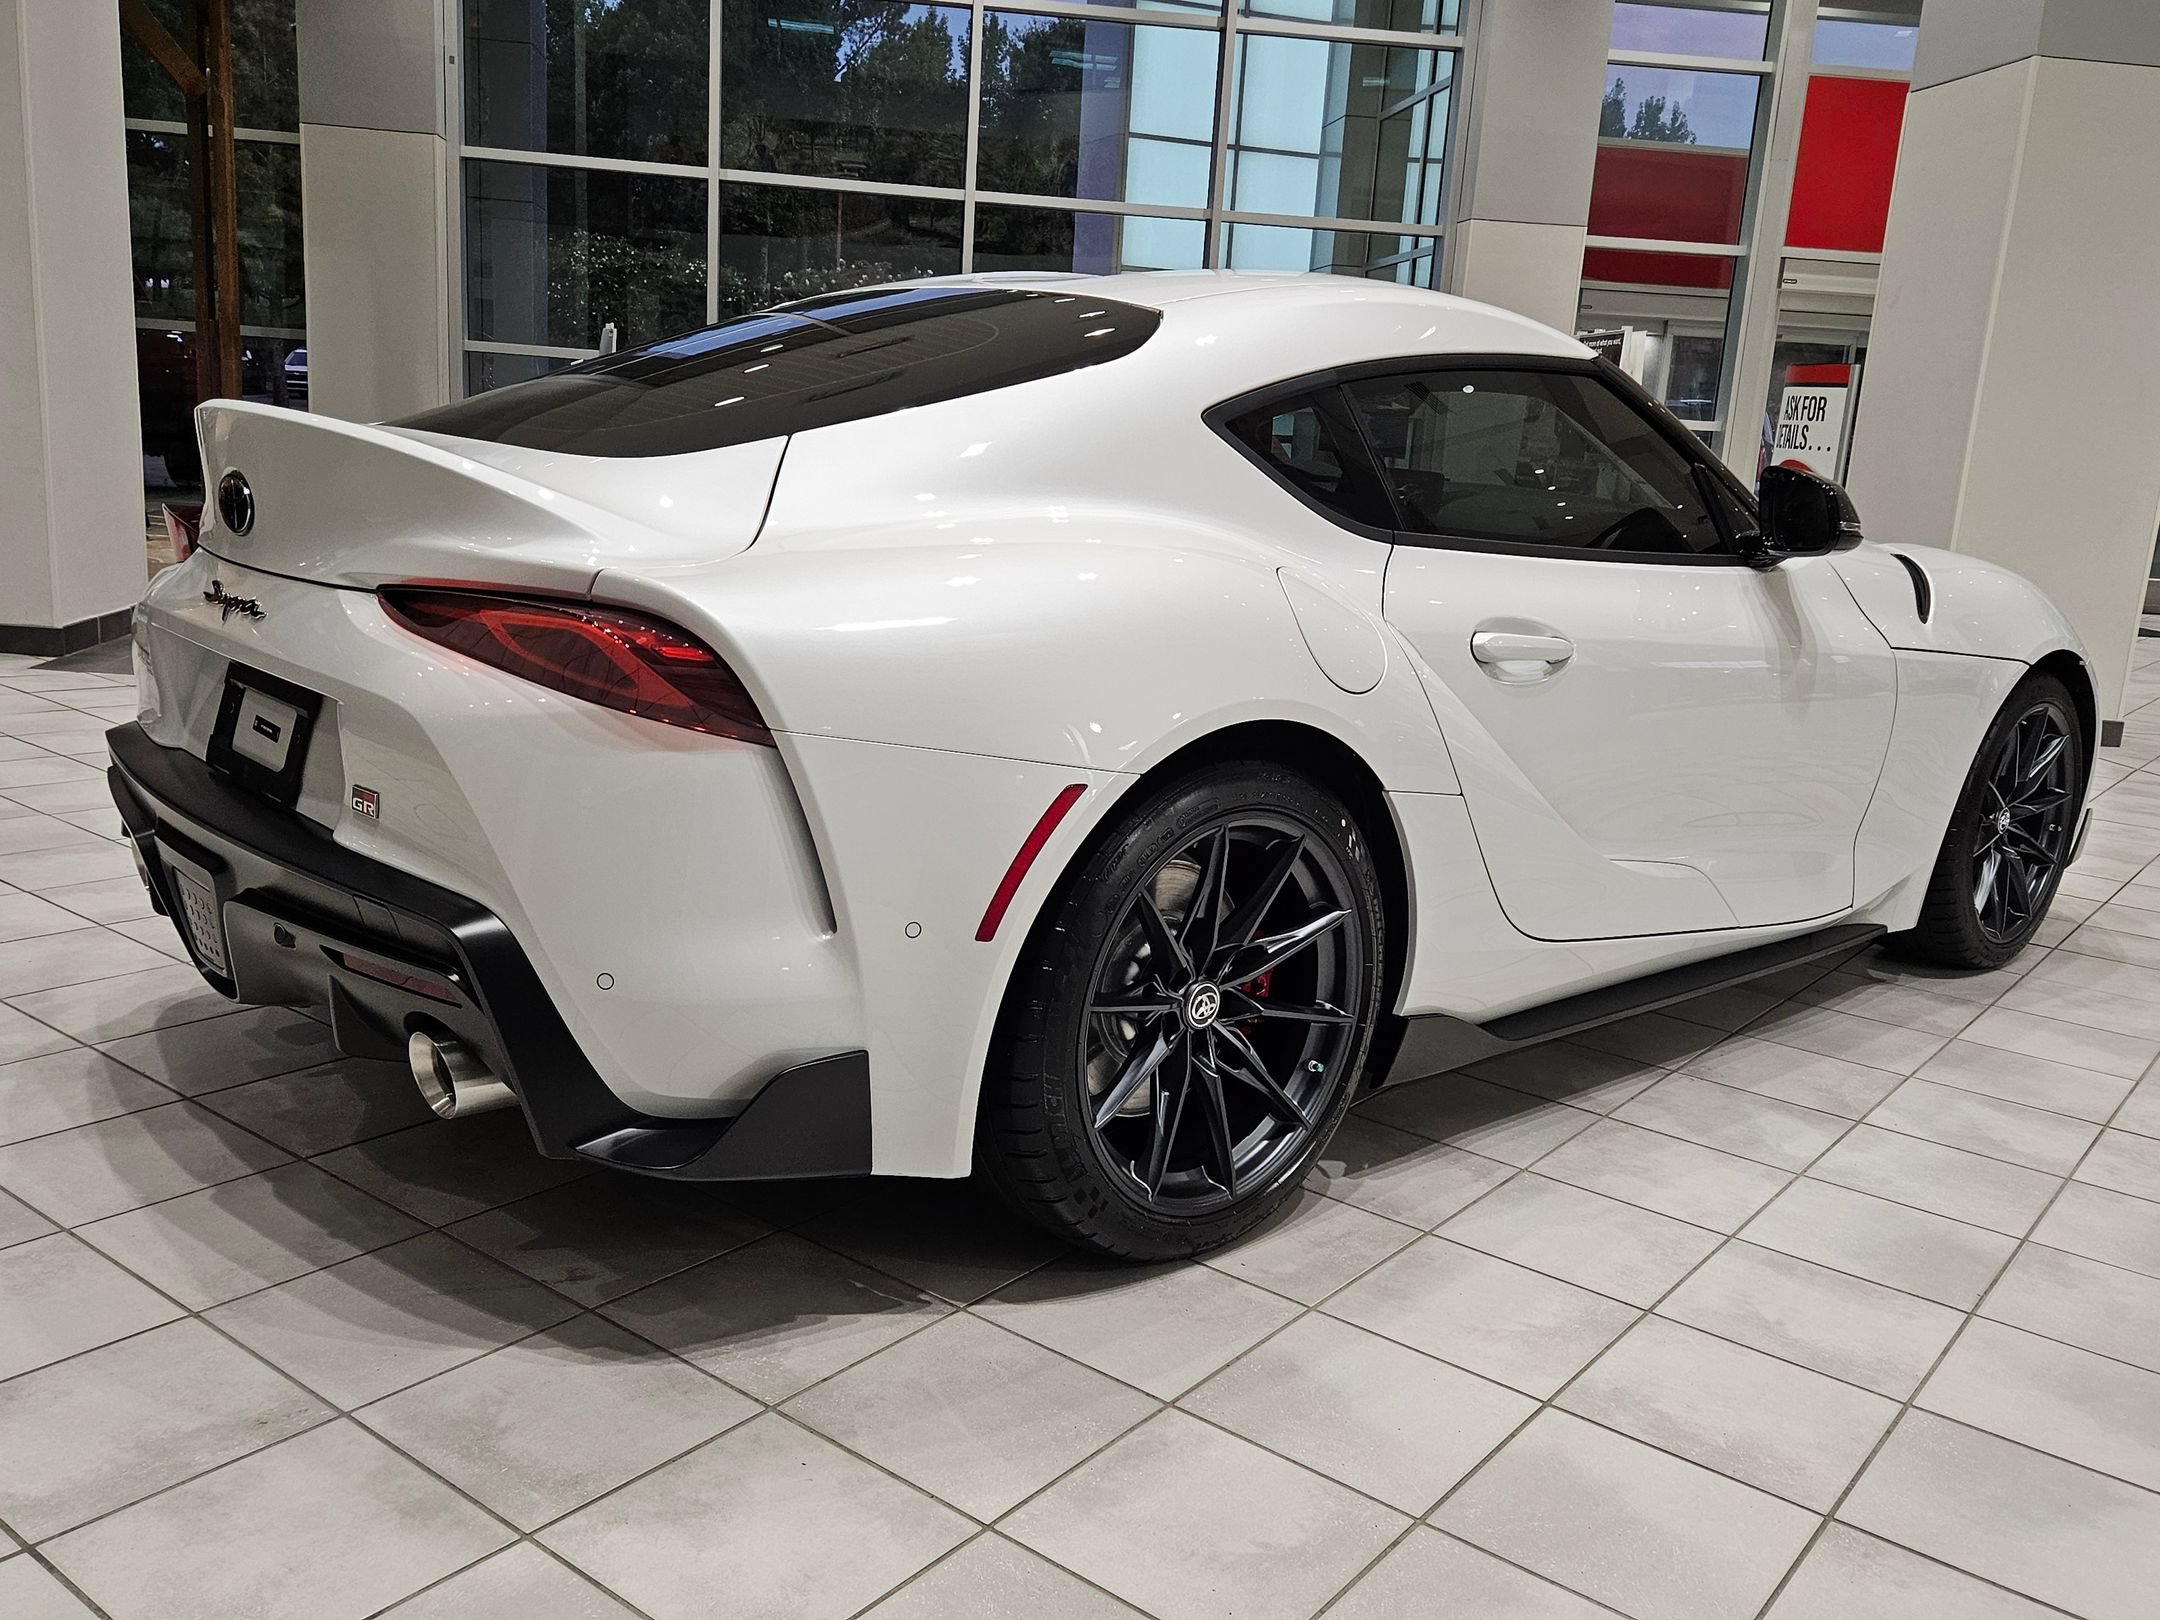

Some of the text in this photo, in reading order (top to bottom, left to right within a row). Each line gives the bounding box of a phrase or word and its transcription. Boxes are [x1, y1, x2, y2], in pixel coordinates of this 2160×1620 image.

[1783, 395, 1828, 422] ASK FOR
[203, 578, 268, 623] Supra
[352, 797, 375, 816] GR
